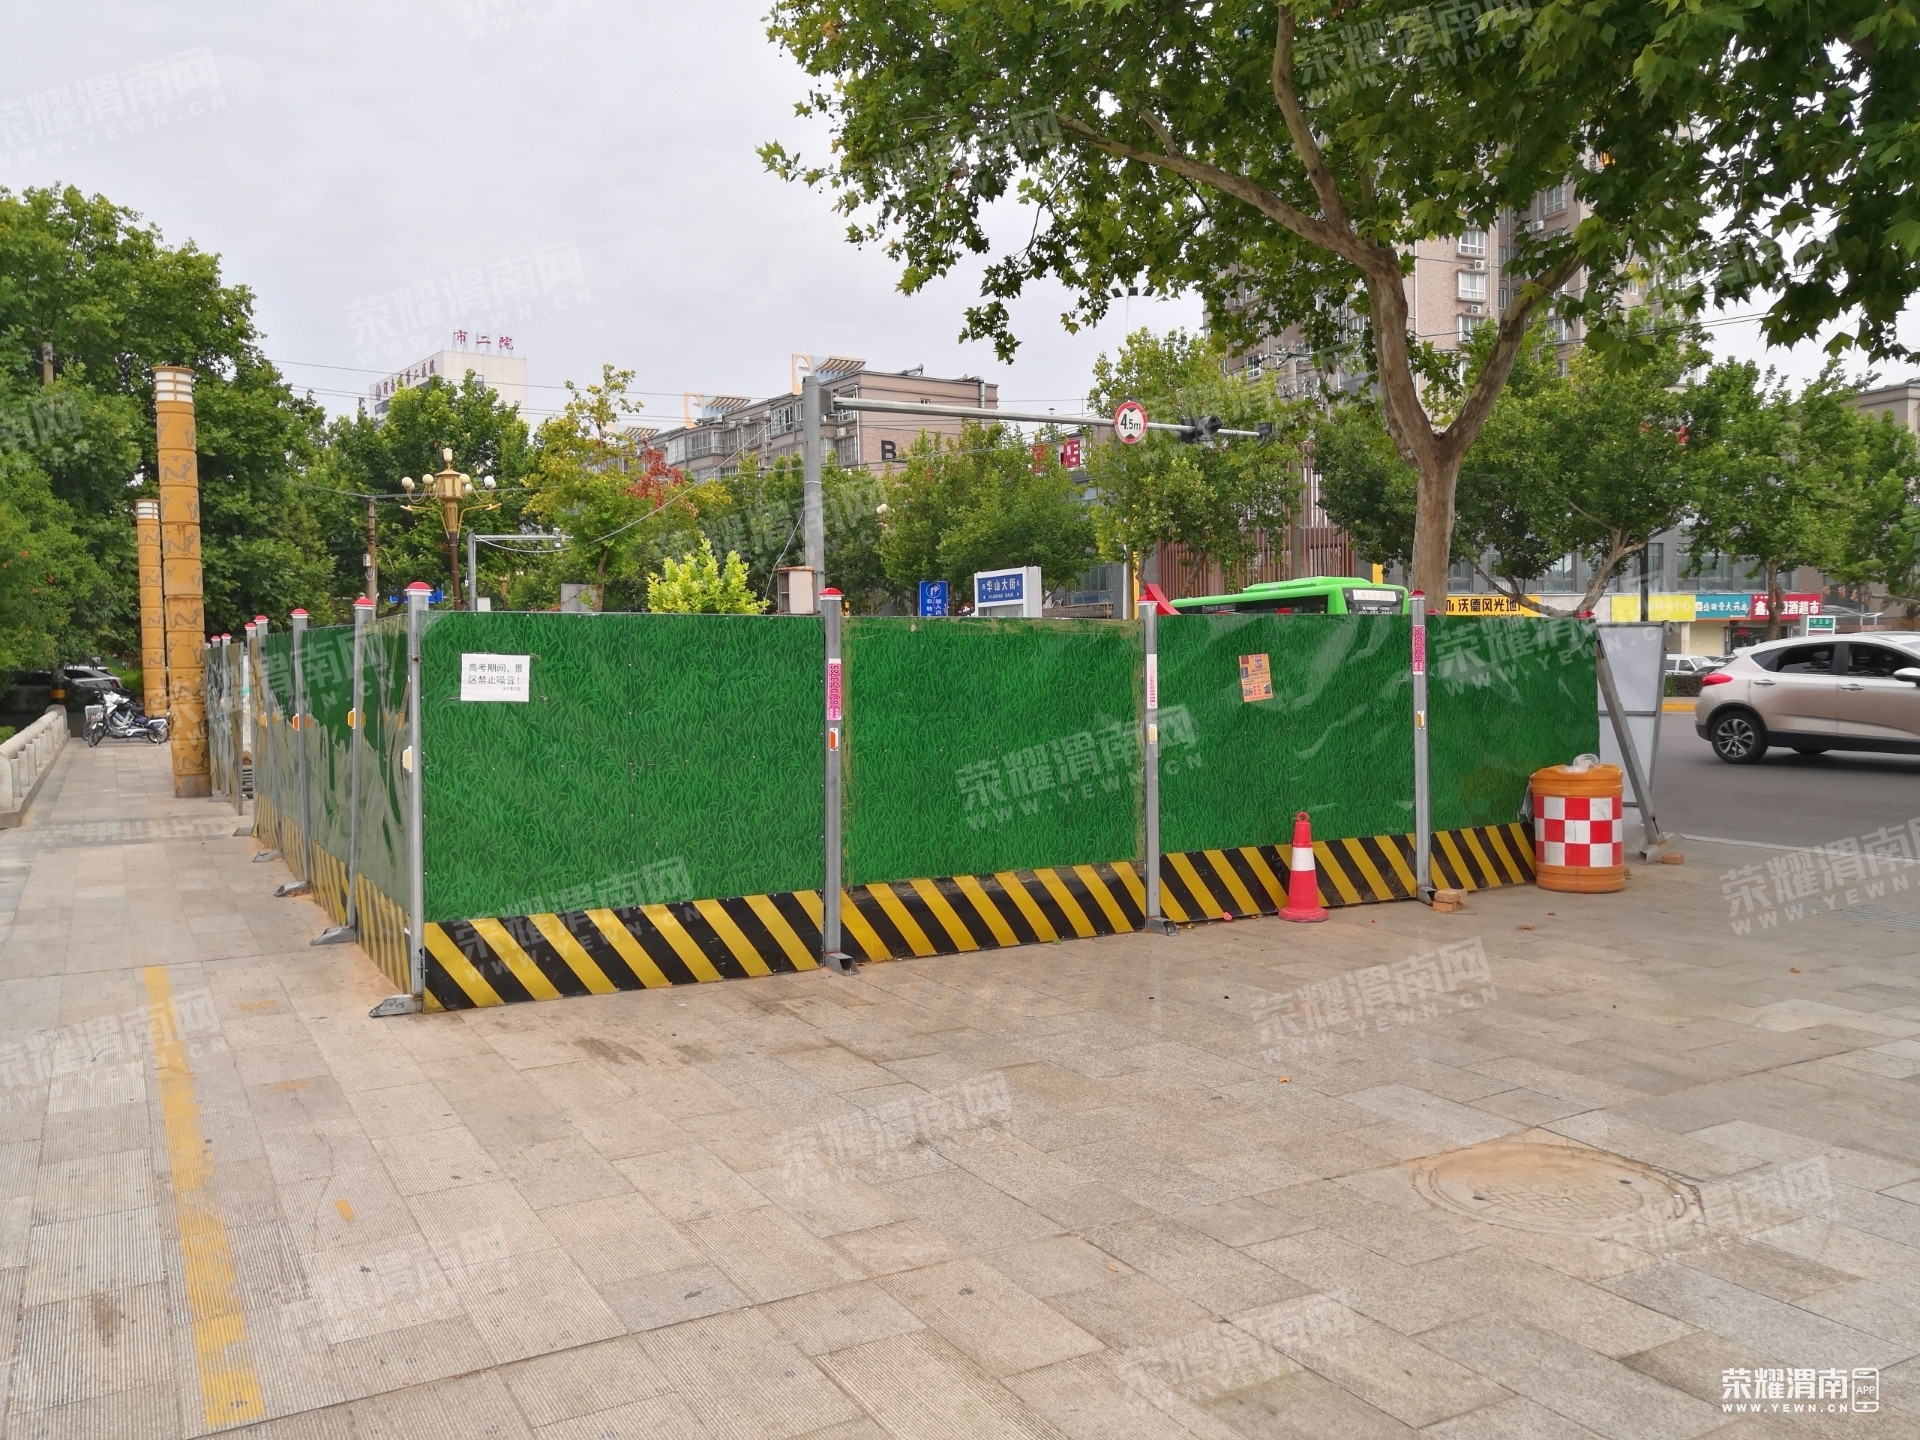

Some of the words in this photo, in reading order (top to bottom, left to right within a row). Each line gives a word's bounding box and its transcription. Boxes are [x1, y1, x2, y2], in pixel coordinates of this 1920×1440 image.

[453, 329, 514, 350] 市二院
[383, 359, 435, 395] 渭南第二医院
[1120, 413, 1141, 431] 4.5m
[881, 440, 897, 462] B
[986, 577, 1016, 593] 华山大街
